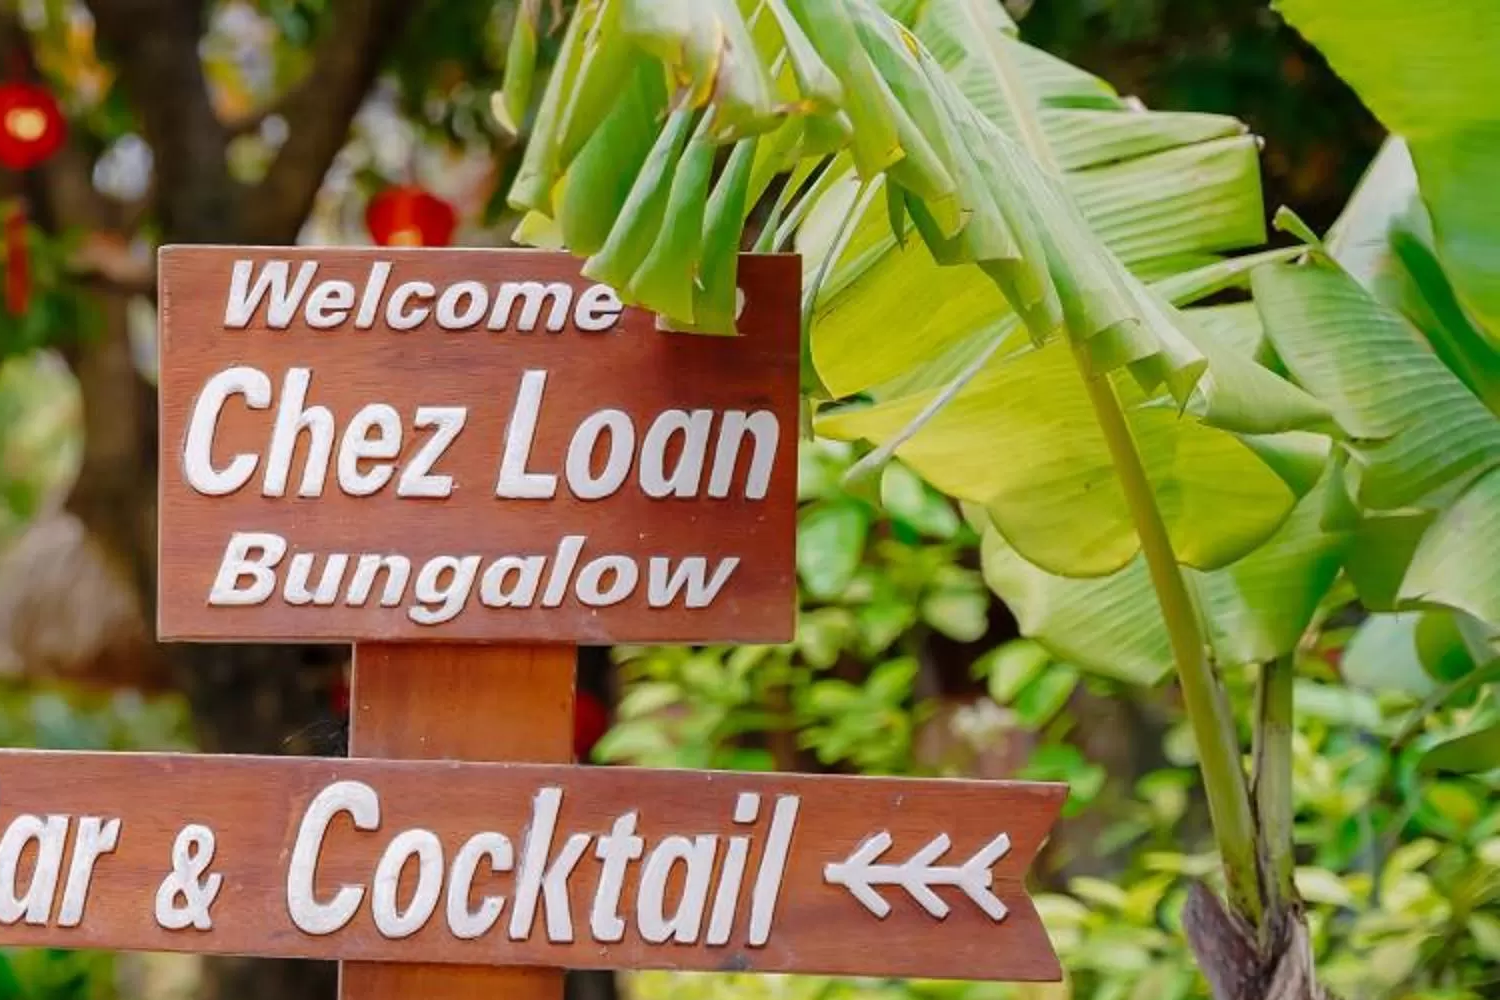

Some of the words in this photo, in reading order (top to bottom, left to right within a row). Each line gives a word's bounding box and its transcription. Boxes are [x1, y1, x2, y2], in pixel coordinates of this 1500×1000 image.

[223, 259, 623, 331] Welcome
[183, 366, 467, 498] Chez
[495, 369, 780, 500] Loan
[208, 531, 740, 626] Bungalow
[155, 824, 223, 931] &
[287, 780, 800, 948] Cocktail
